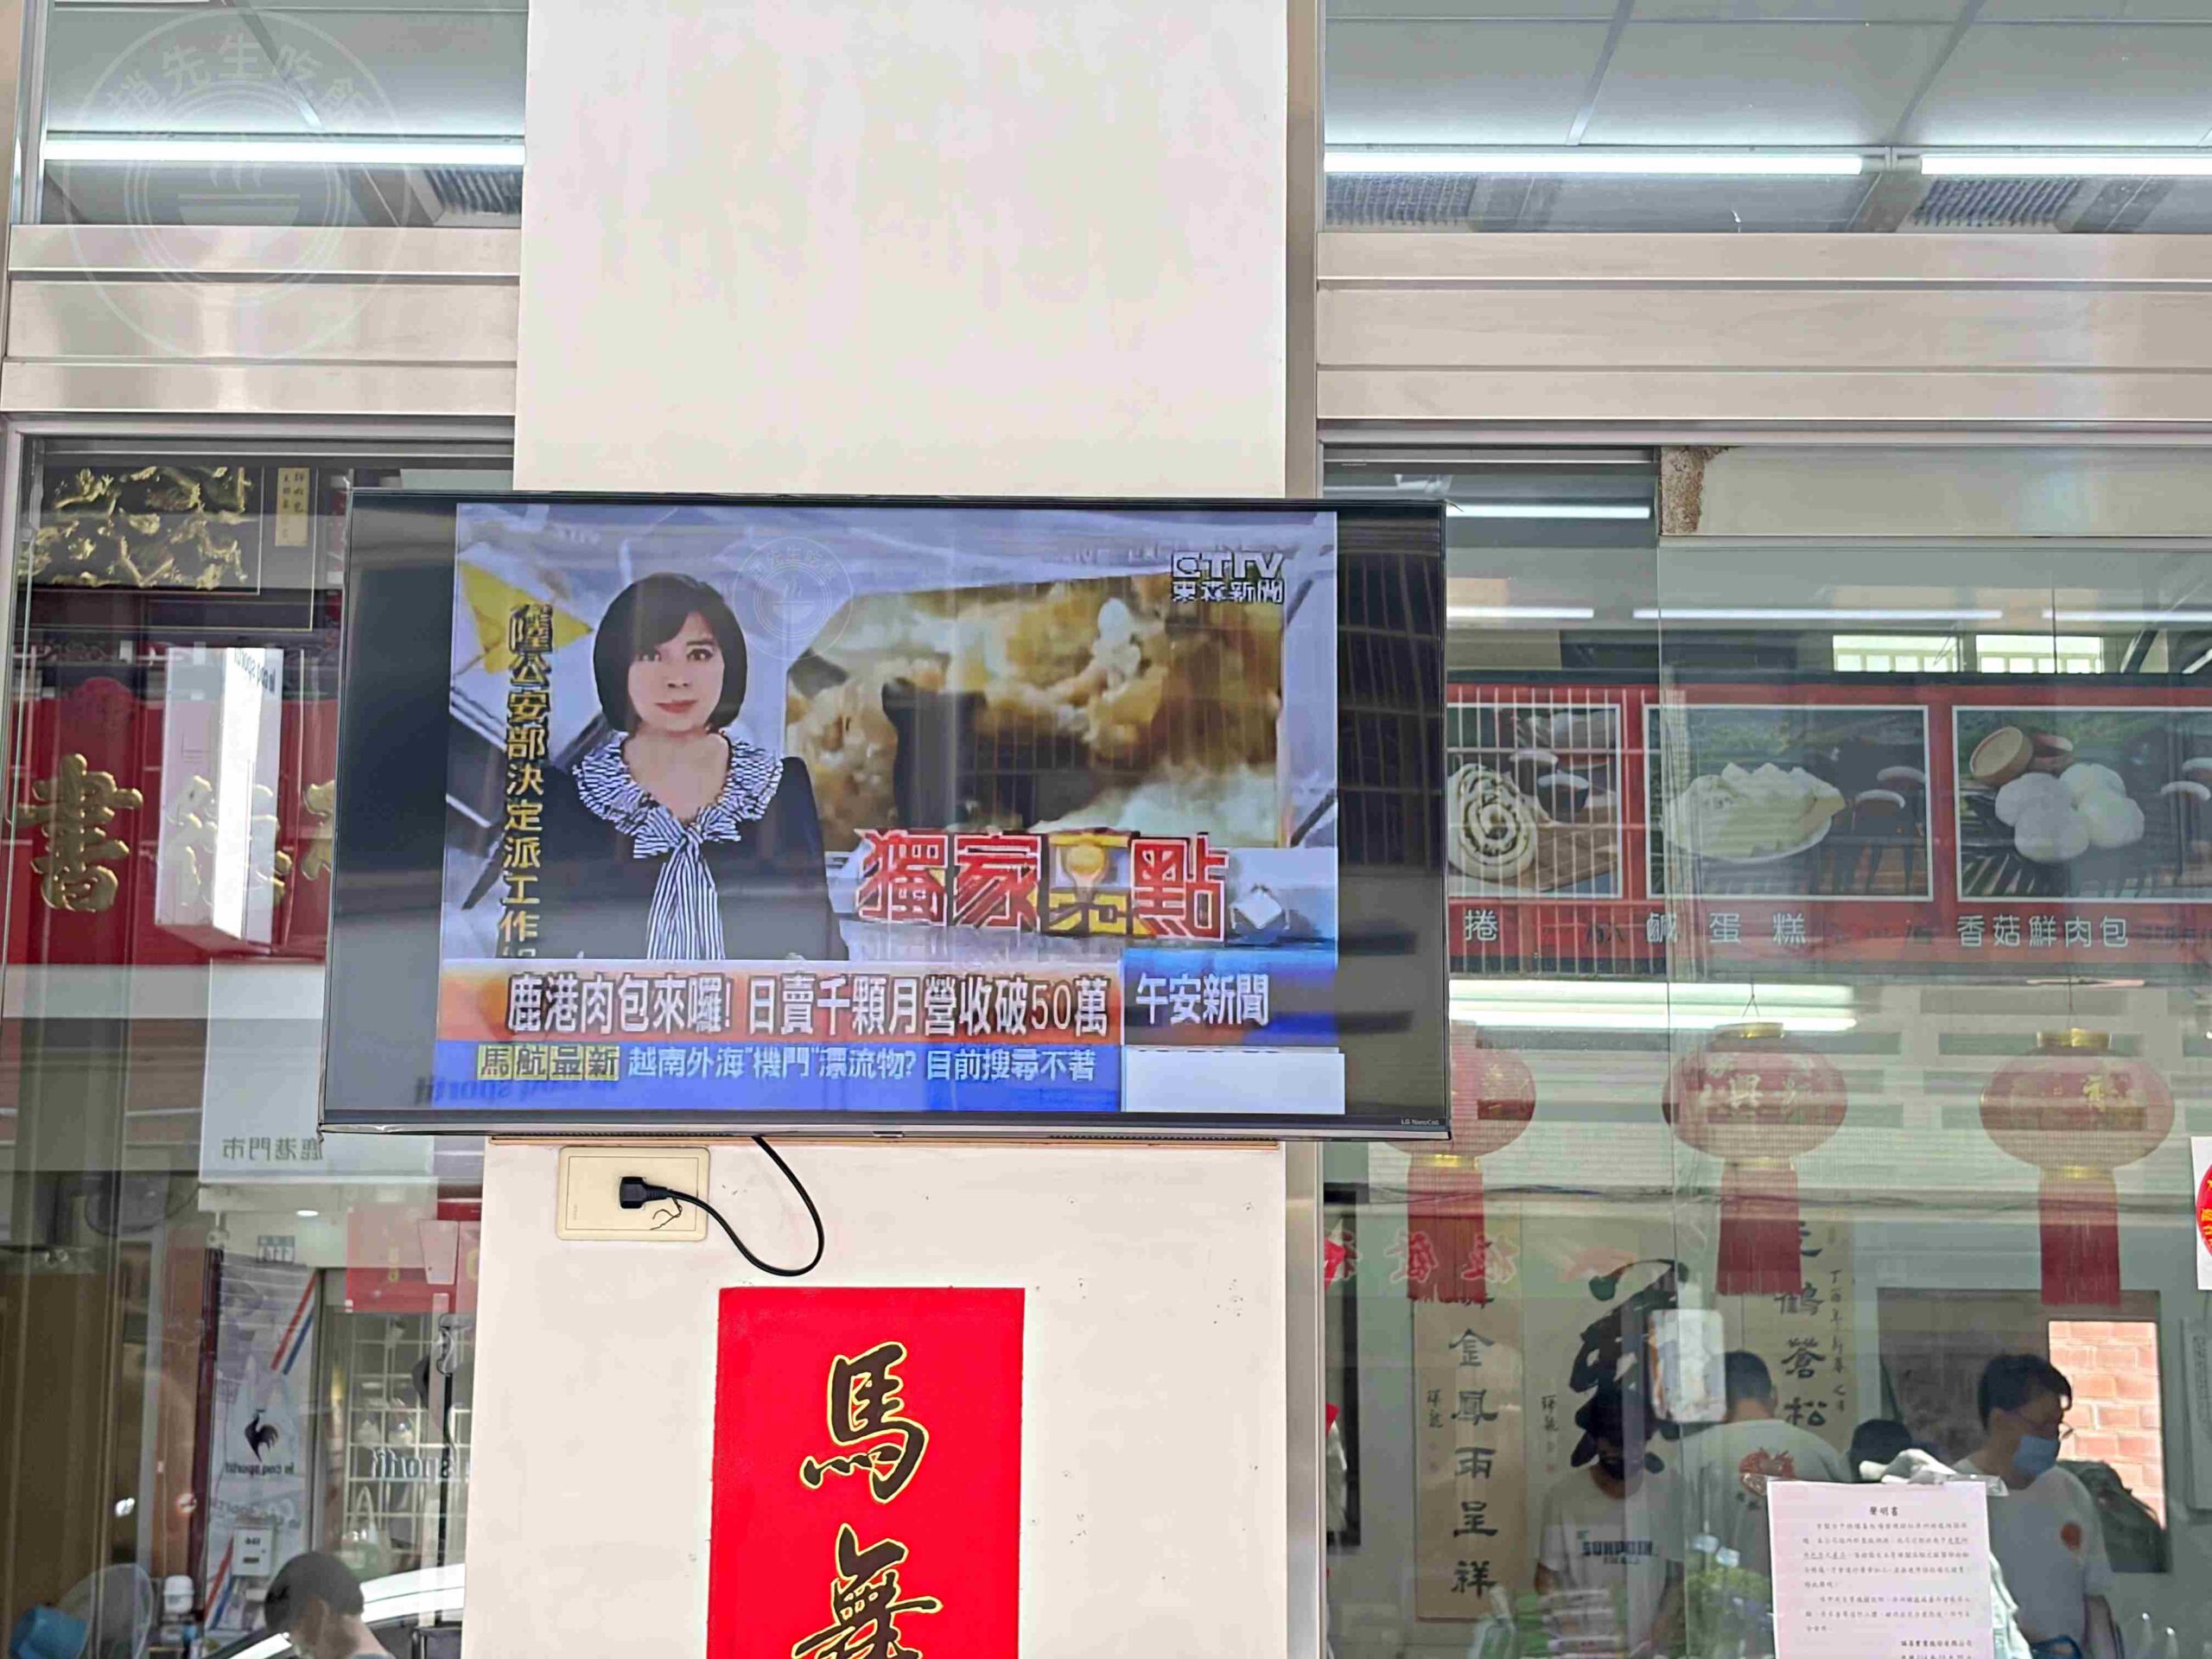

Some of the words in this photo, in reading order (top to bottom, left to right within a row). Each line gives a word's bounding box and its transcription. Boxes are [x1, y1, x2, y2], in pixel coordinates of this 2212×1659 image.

[1957, 916, 2128, 948] 香菇鮮肉包
[1135, 973, 1270, 1027] 午安新聞
[480, 1045, 620, 1077] 馬航最新
